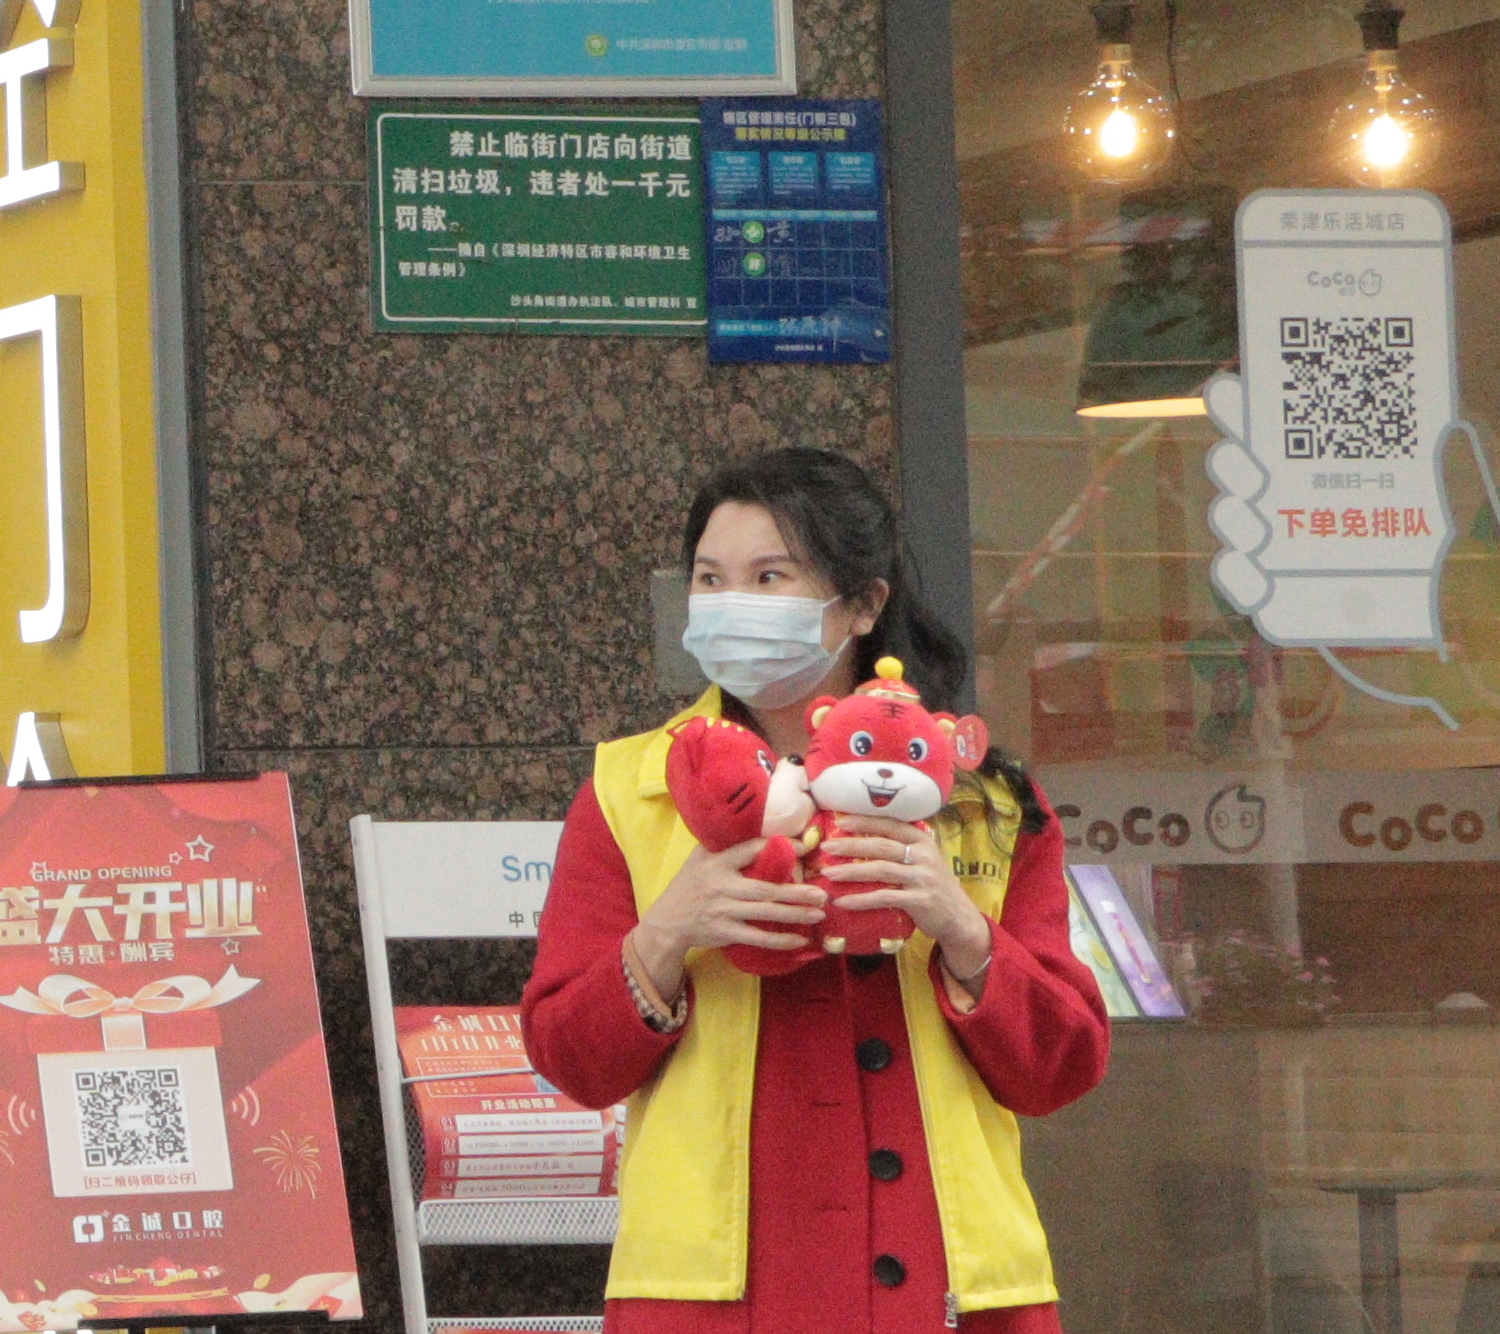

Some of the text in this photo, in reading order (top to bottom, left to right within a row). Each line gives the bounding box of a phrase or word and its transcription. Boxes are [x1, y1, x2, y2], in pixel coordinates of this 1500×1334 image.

[450, 131, 692, 160] 禁止临街门店向街道
[393, 168, 691, 197] 清扫垃圾，违者处一千元
[1280, 212, 1405, 231] 荣津乐活城店
[1312, 473, 1395, 490] 微信扫一扫
[1277, 508, 1432, 538] 下单免排队
[32, 866, 172, 882] GRAND OPENING
[432, 1015, 521, 1032] 金诚口
[112, 1210, 223, 1233] 金诚口腔
